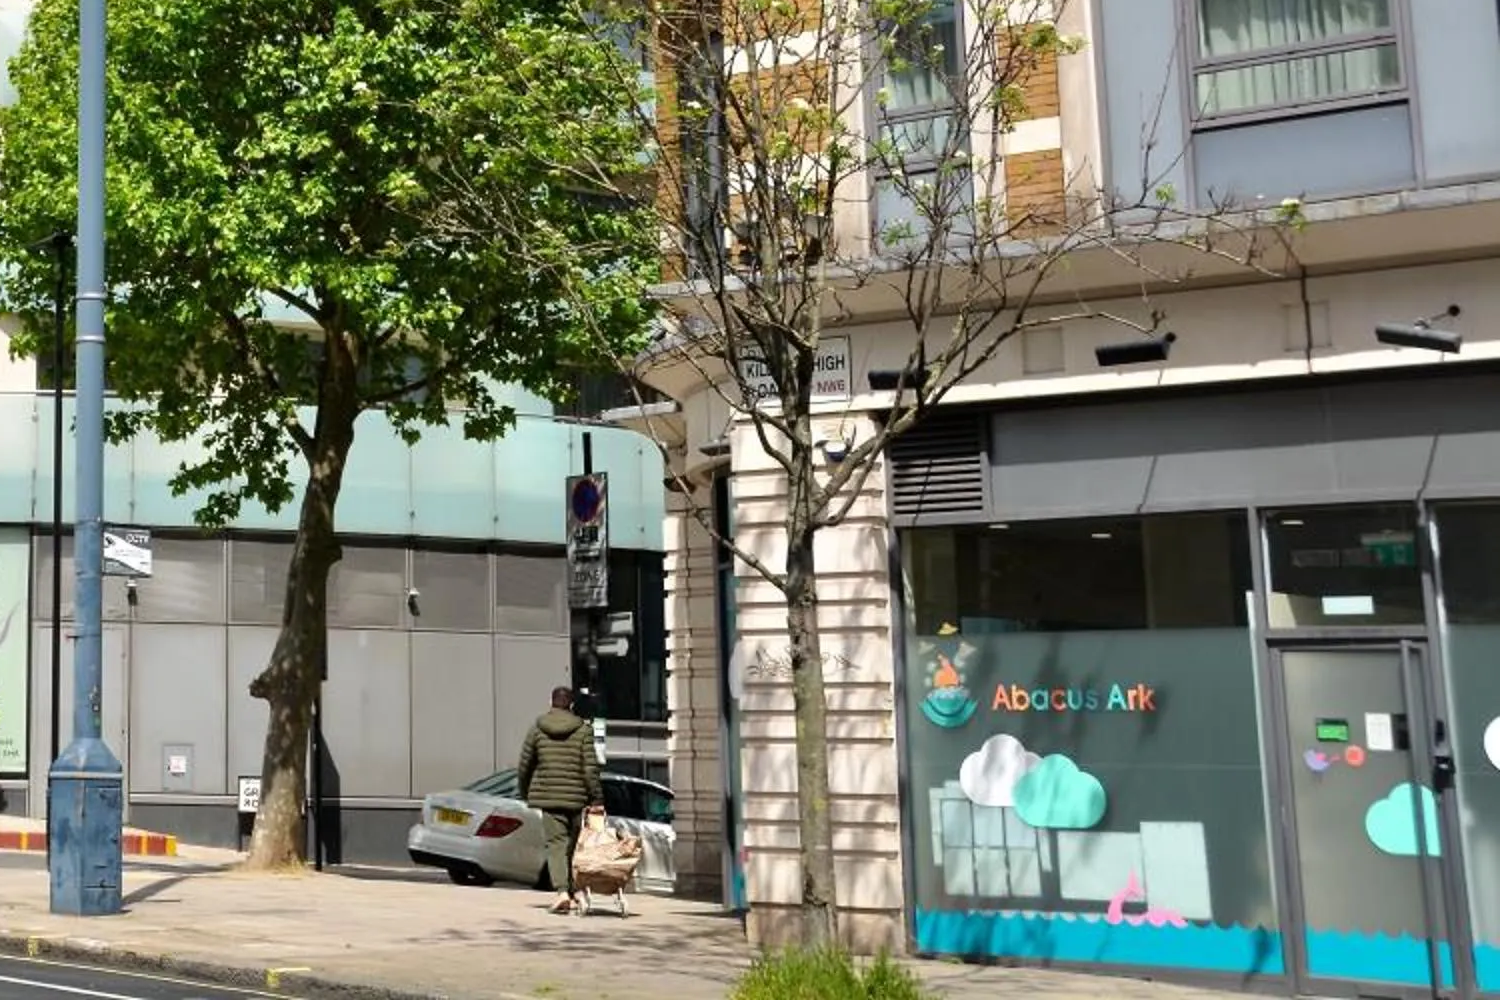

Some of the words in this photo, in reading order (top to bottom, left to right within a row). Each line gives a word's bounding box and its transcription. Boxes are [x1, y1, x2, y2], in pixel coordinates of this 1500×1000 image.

[811, 354, 845, 372] HIGH
[817, 380, 844, 393] NW6
[992, 682, 1100, 712] Abacus
[1107, 682, 1156, 712] Ark
